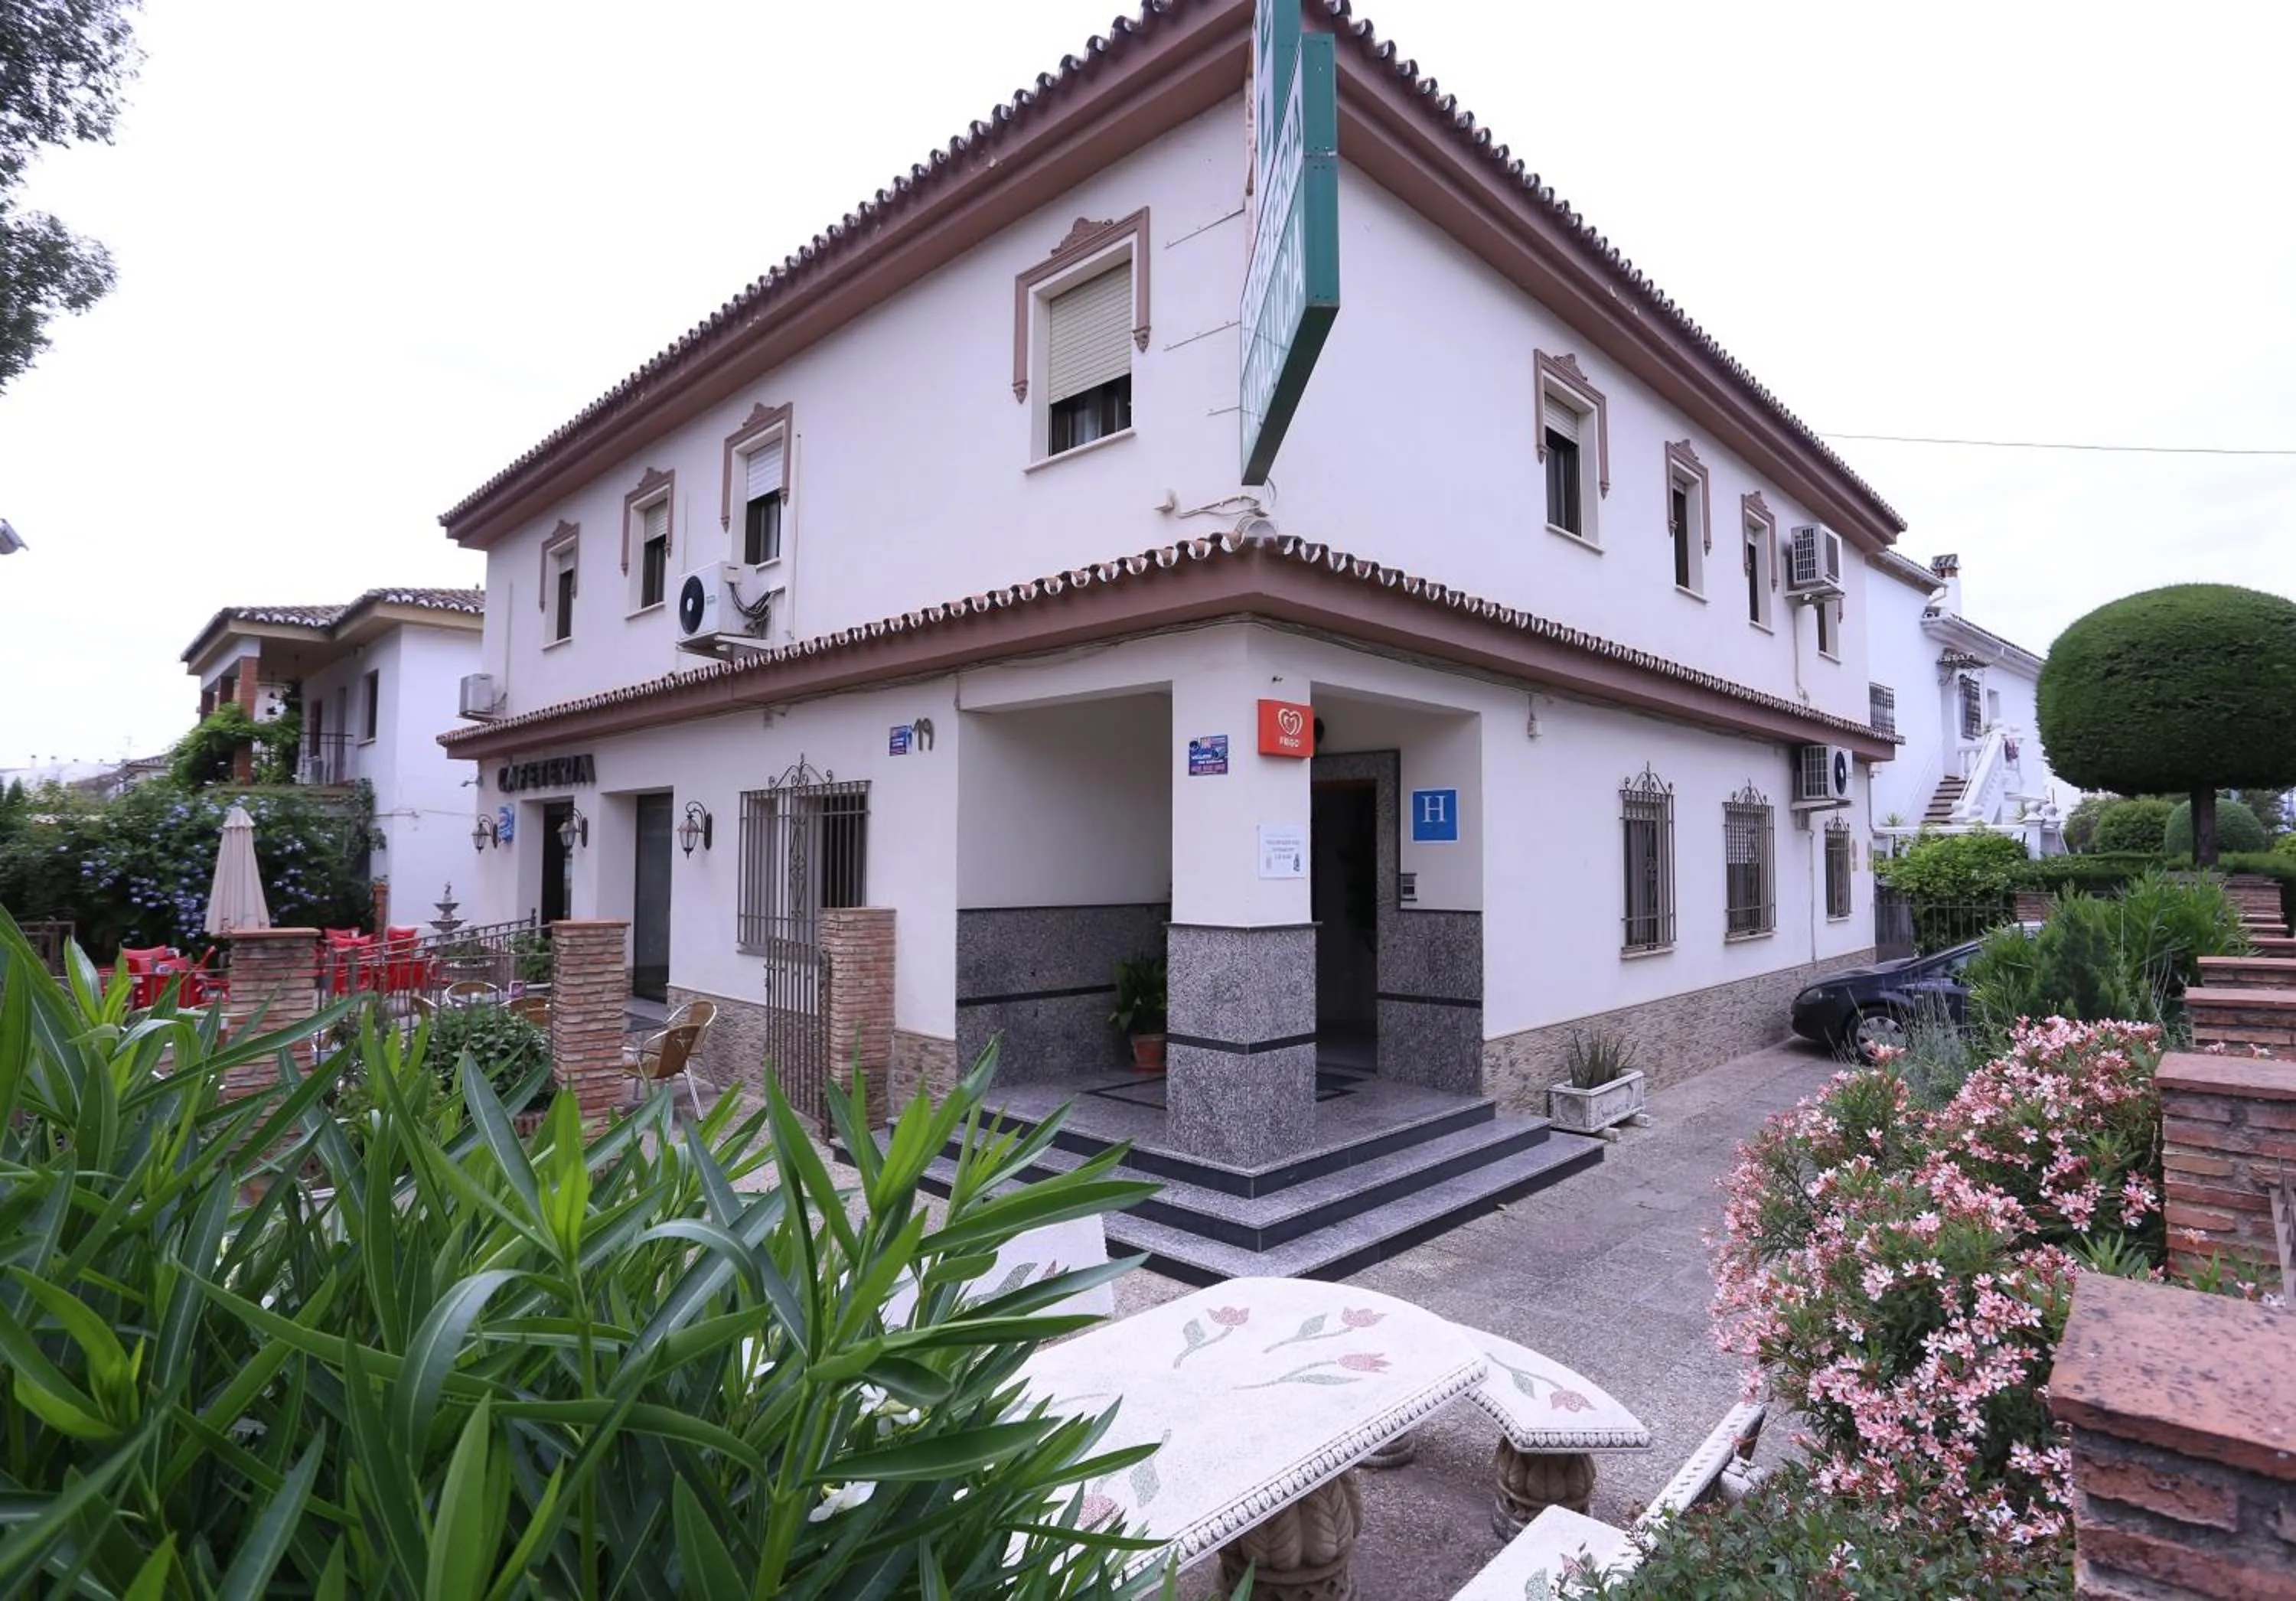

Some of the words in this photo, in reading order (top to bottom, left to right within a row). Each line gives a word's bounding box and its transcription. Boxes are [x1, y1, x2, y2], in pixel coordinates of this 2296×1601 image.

[1244, 94, 1301, 353] CAFETERIA
[497, 754, 596, 793] CAFETERIA
[1421, 795, 1447, 823] H
